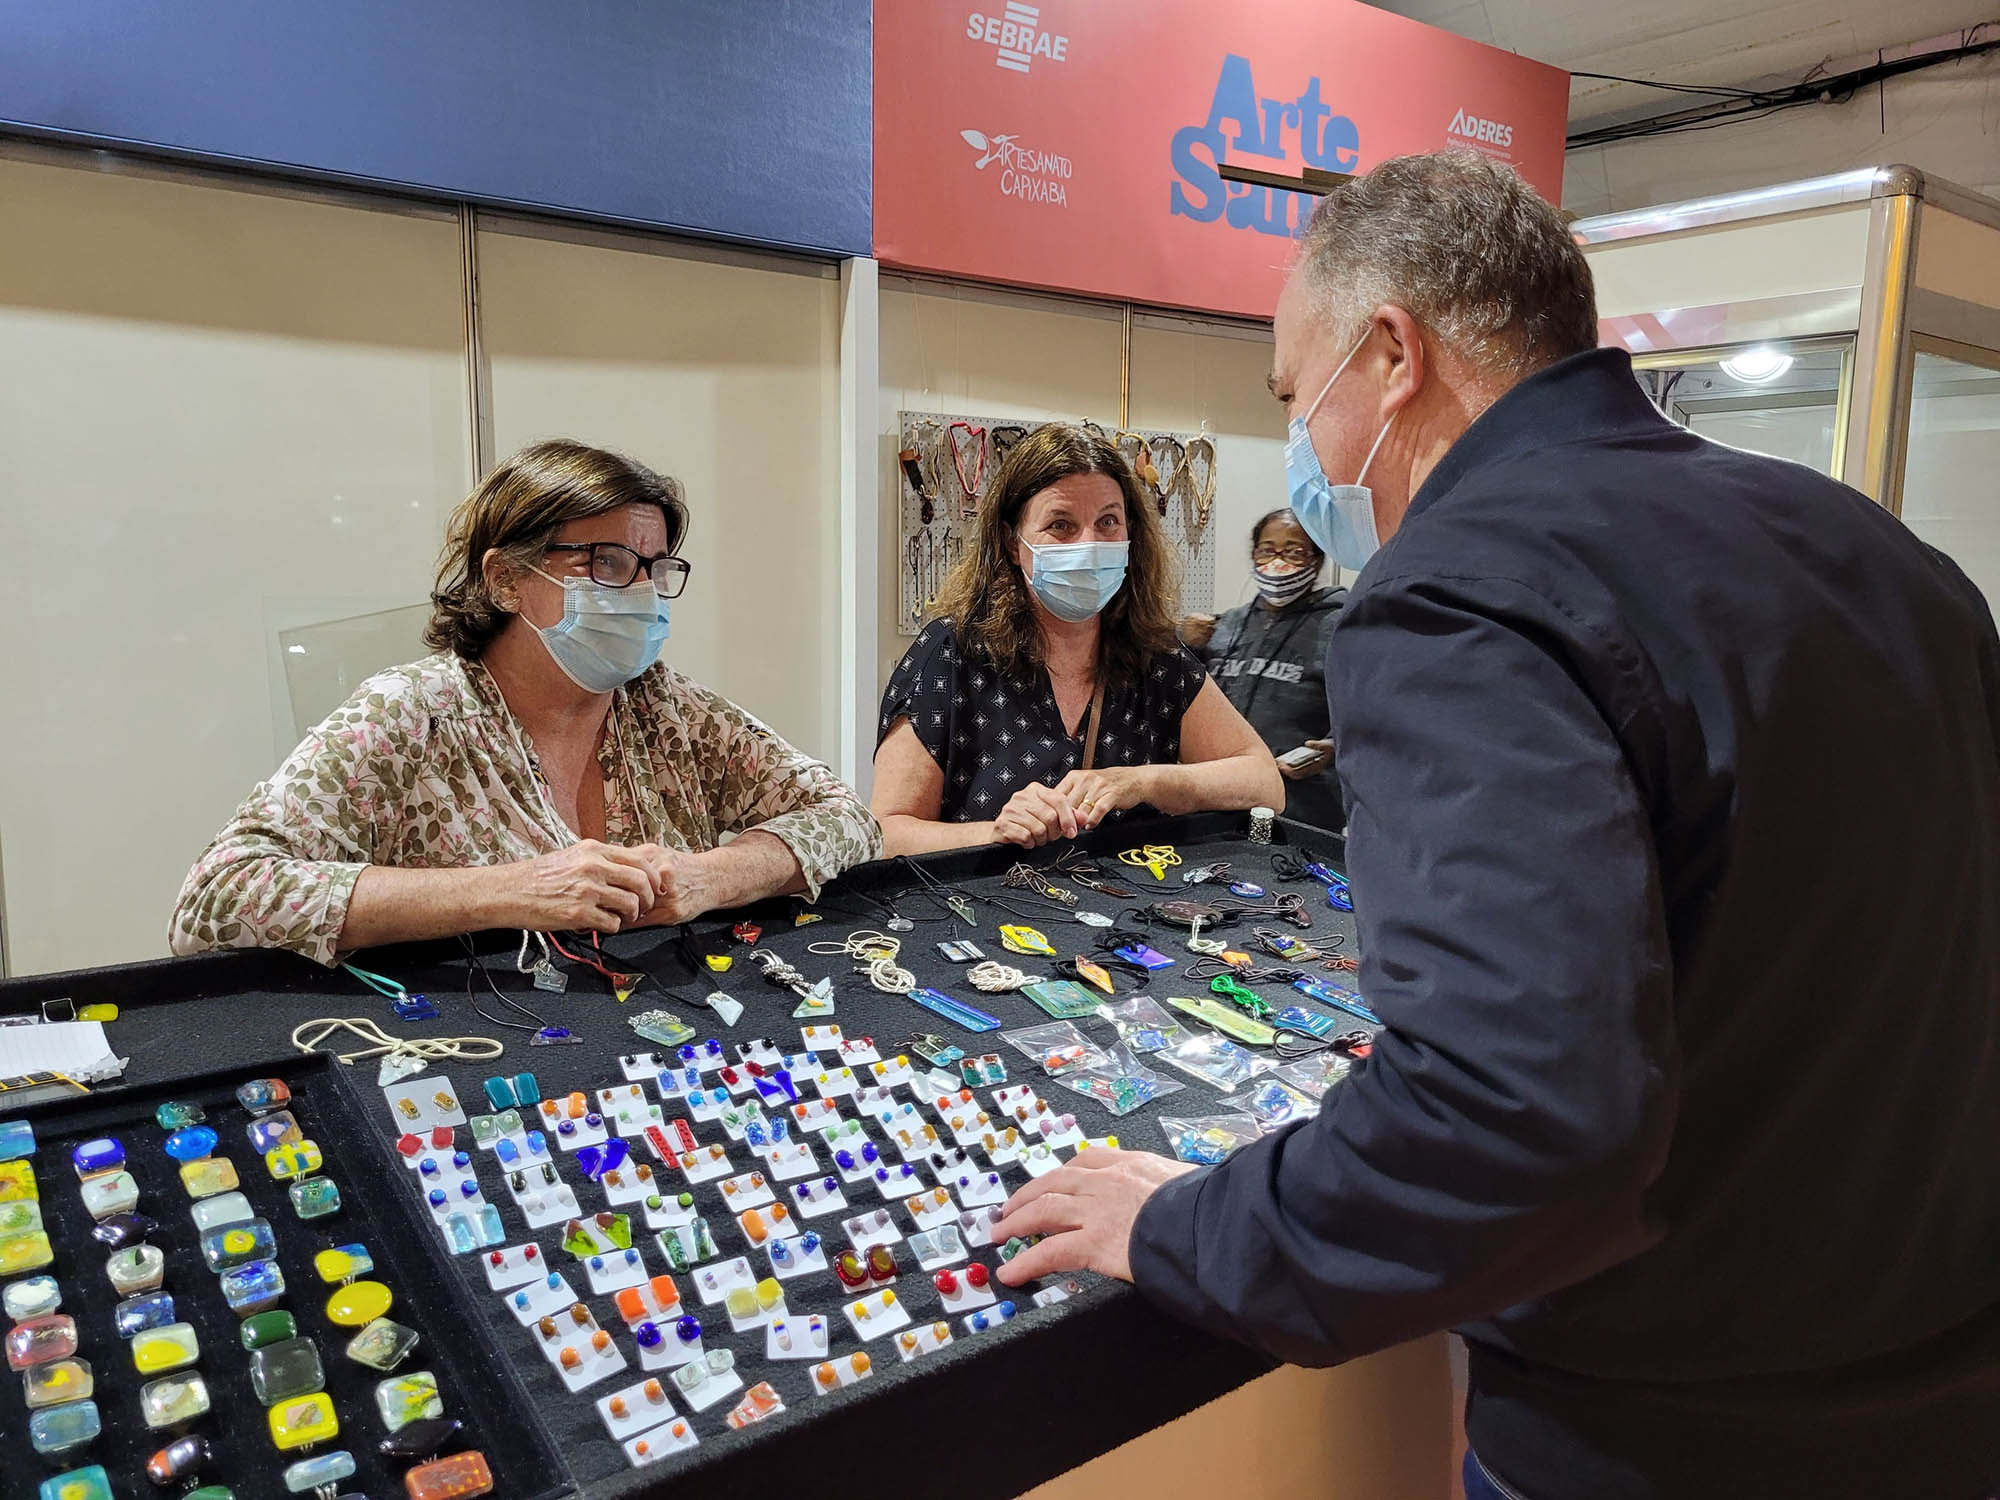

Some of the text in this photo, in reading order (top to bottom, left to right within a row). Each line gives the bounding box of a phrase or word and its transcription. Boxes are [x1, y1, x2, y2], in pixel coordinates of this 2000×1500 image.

[967, 12, 1069, 62] SEBRAE
[1204, 52, 1360, 174] Arte
[1447, 106, 1513, 148] ADERES
[996, 139, 1072, 178] ARTESANATO
[1001, 169, 1067, 208] CAPIXABA
[1170, 125, 1327, 241] San
